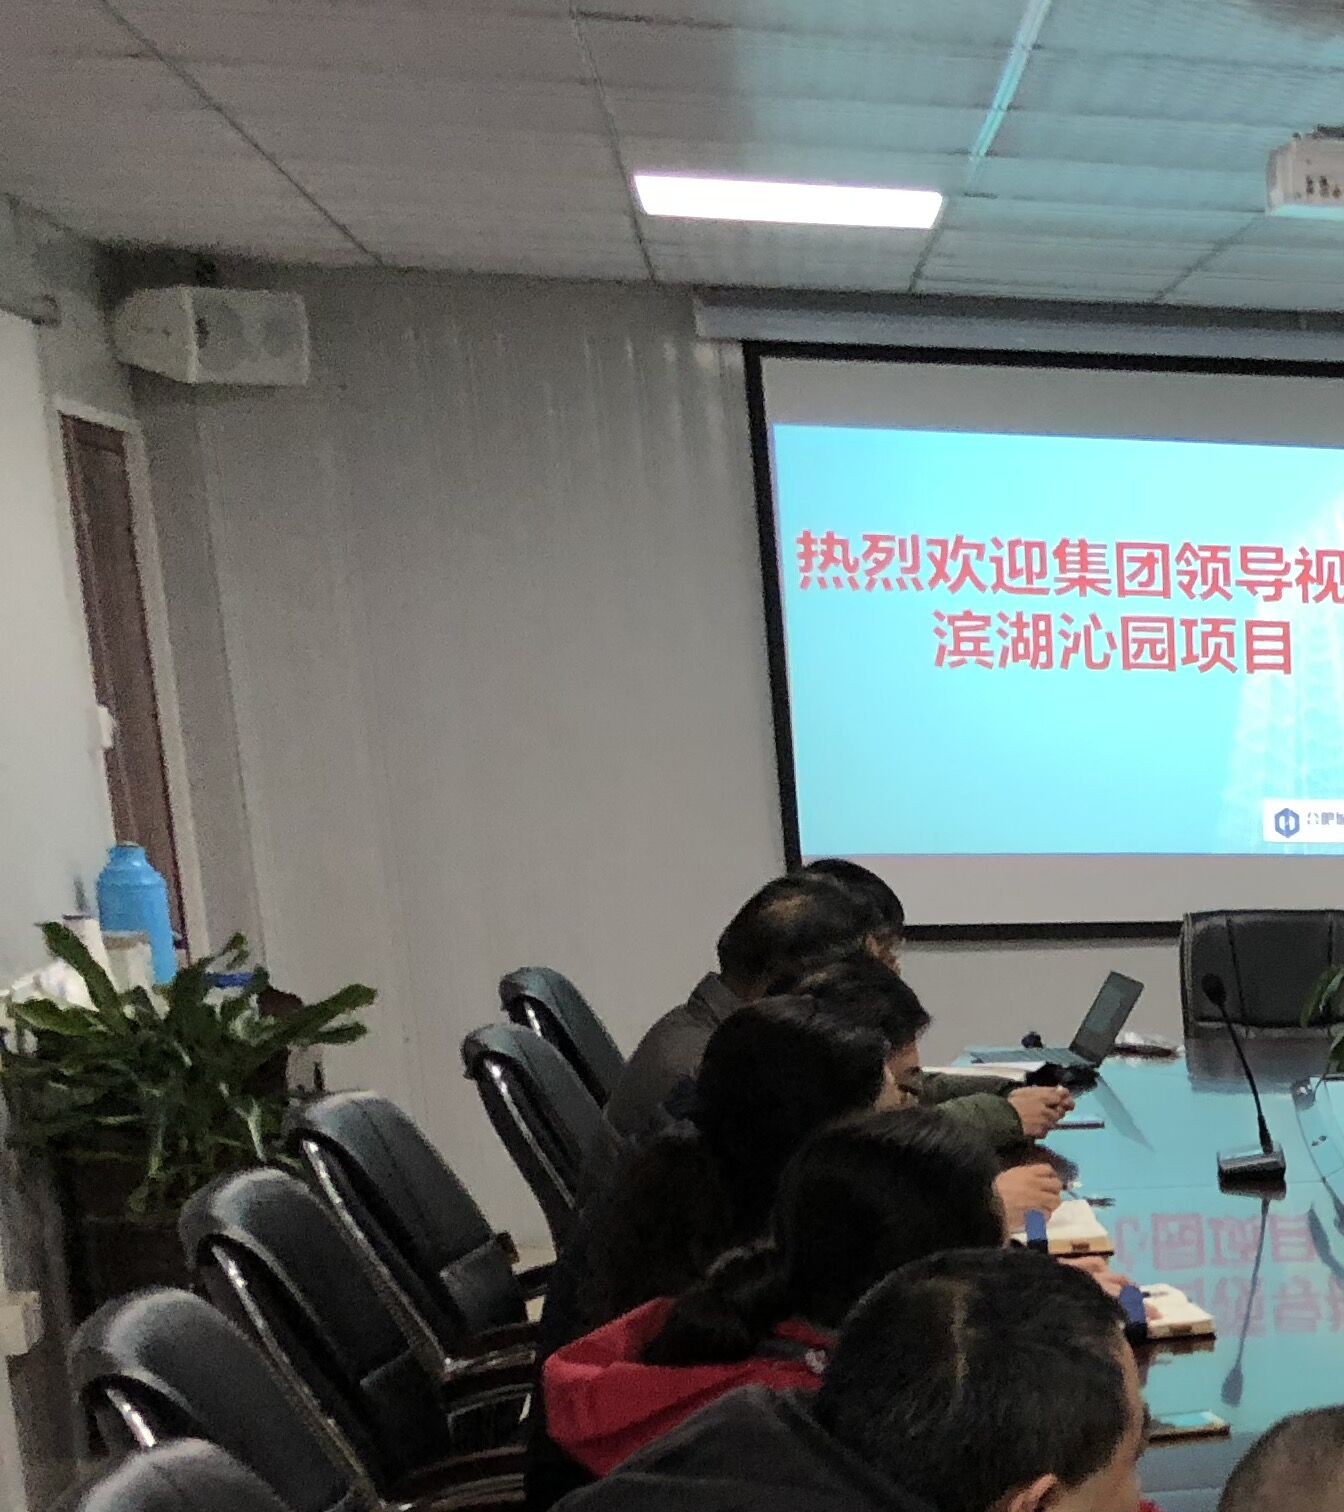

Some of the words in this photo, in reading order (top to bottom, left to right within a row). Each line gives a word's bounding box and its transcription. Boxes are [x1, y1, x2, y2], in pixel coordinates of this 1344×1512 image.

[933, 609, 1293, 675] 滨湖沁园项目
